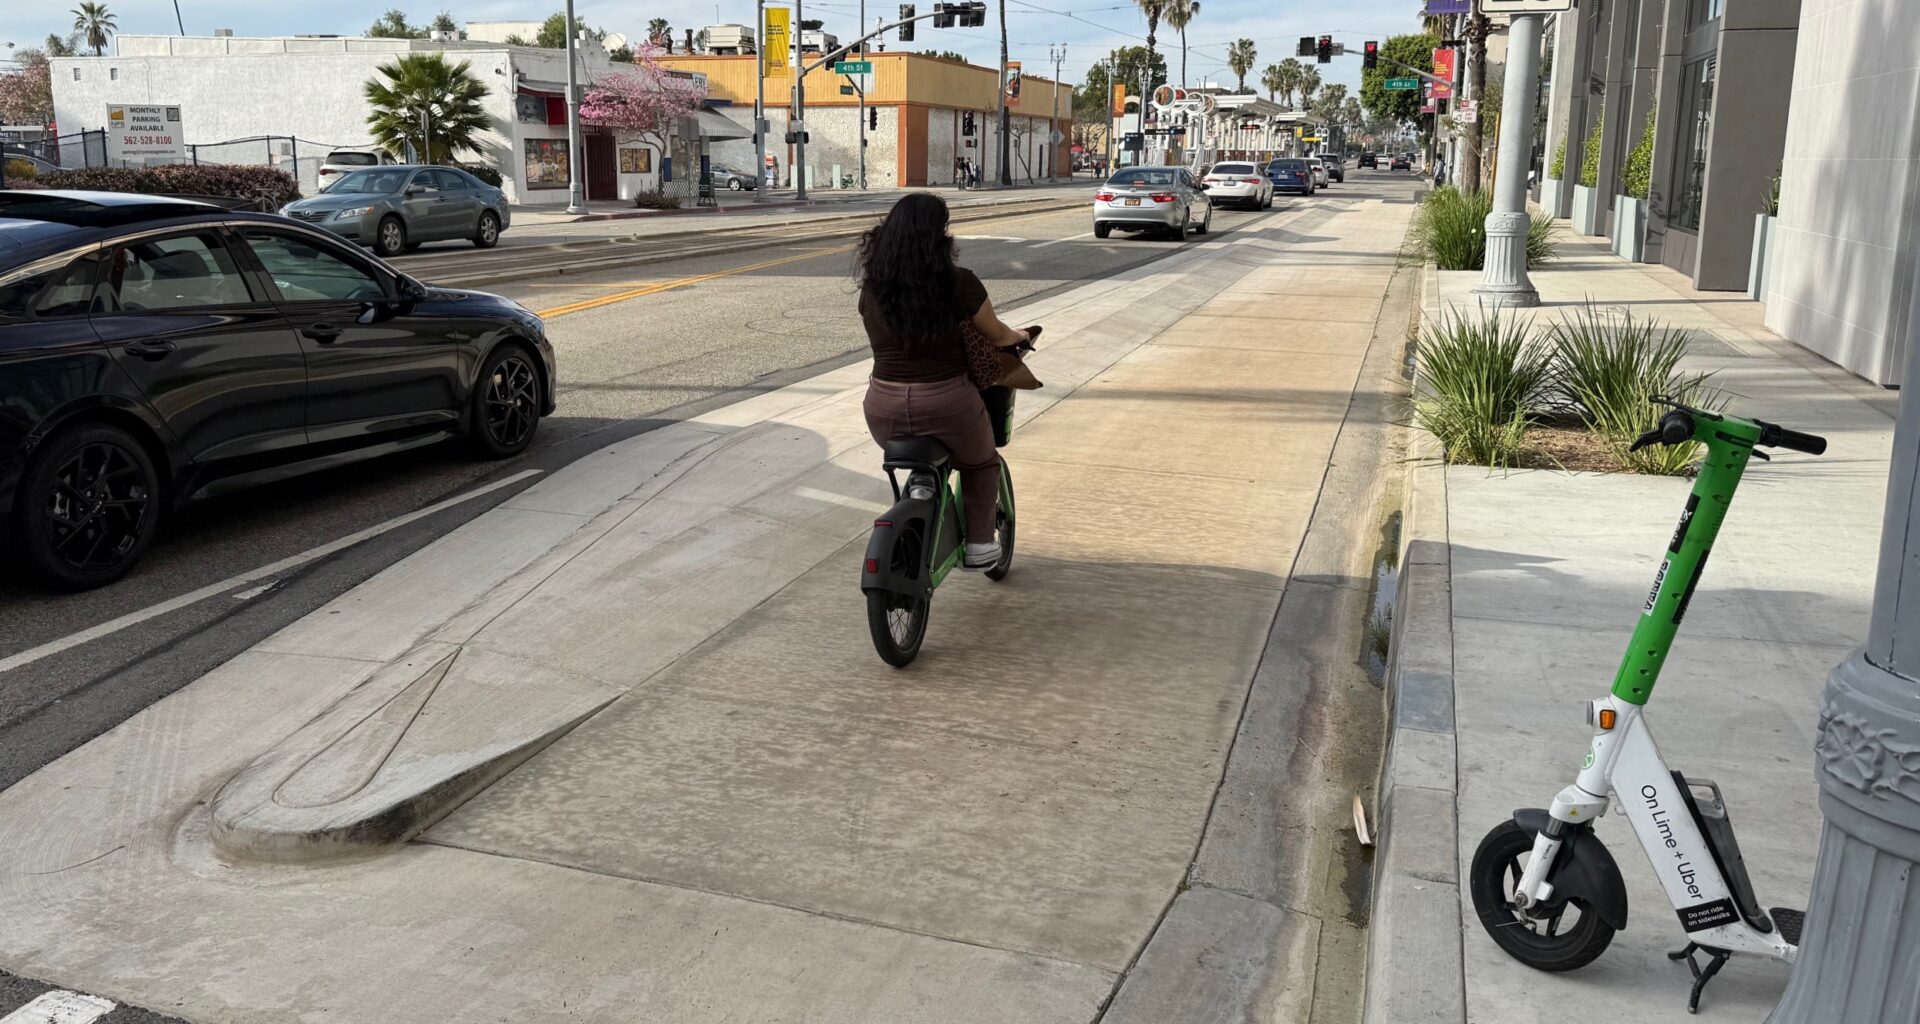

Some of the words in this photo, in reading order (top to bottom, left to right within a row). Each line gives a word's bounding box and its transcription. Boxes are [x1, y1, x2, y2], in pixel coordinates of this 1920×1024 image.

[842, 64, 855, 72] 4th
[856, 64, 864, 72] St
[123, 136, 172, 145] 562-528-8100
[1641, 784, 1659, 809] On
[1651, 810, 1677, 849] Lime
[1677, 861, 1703, 899] Uber
[1697, 912, 1731, 924] sidewalks
